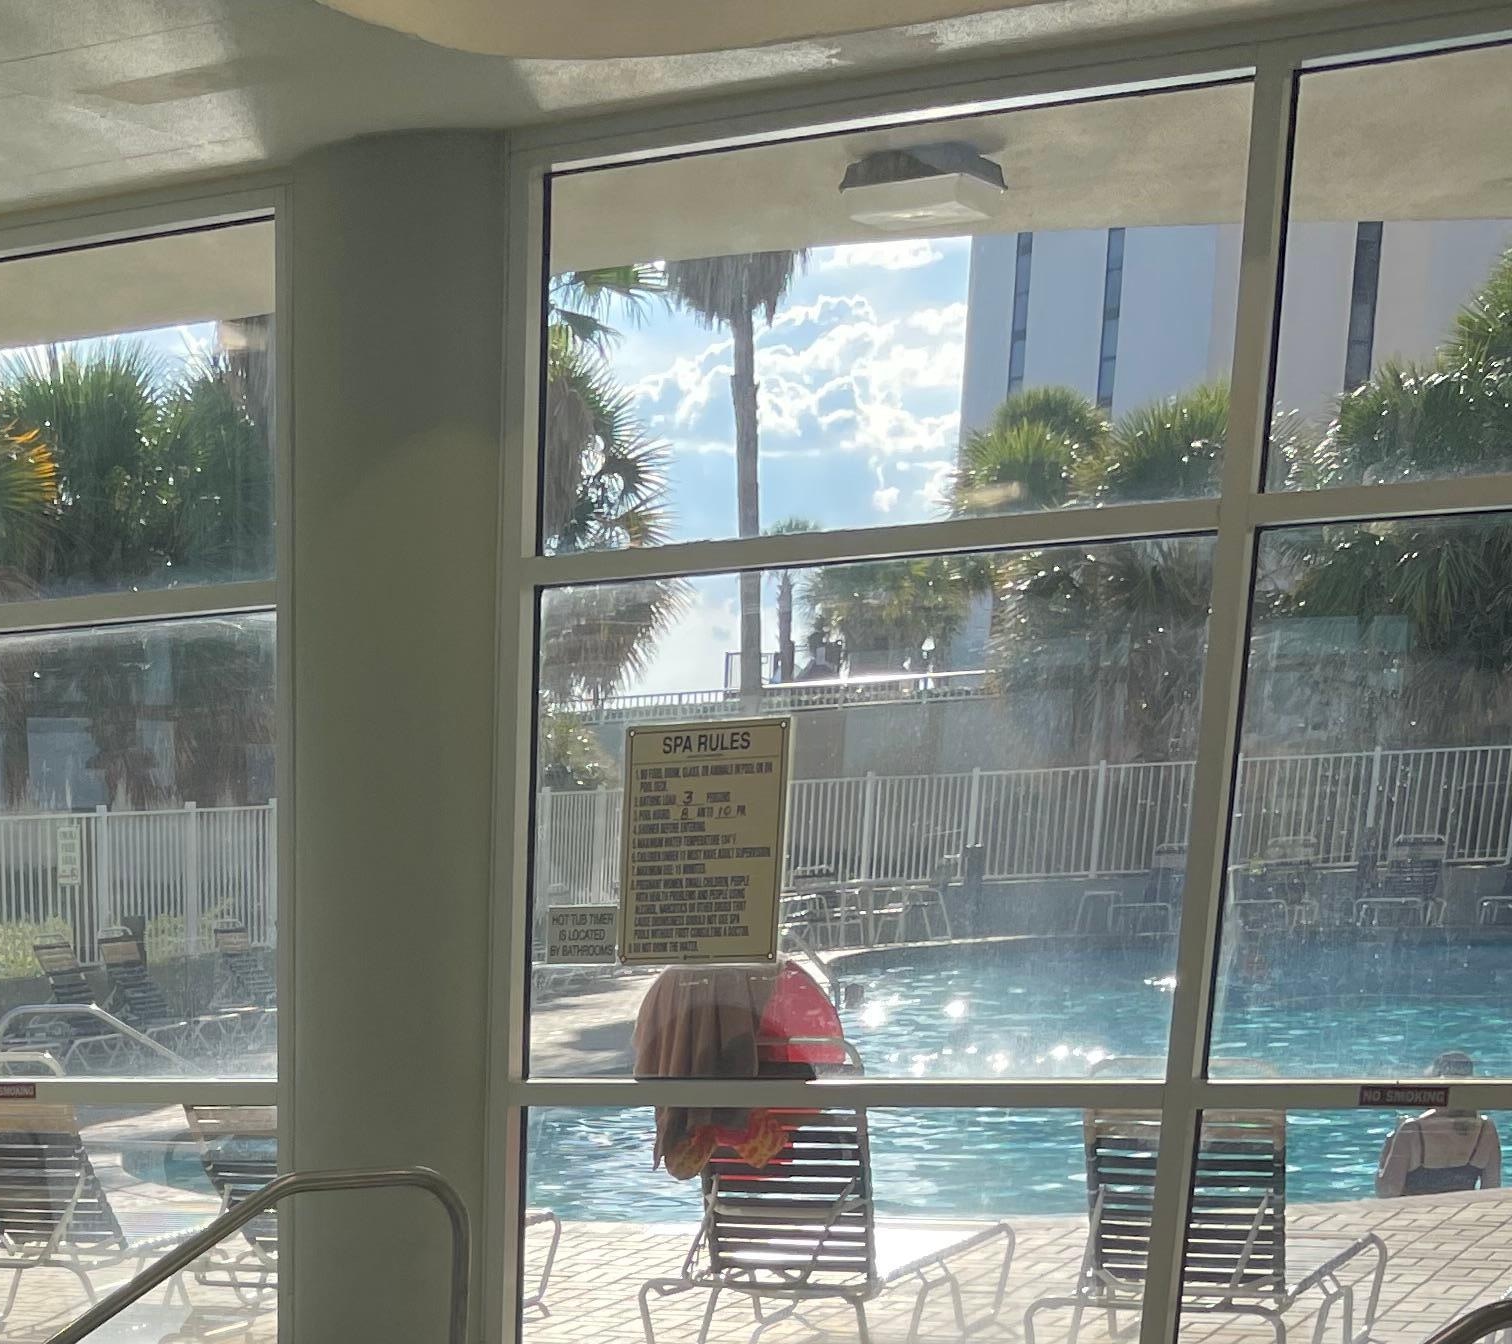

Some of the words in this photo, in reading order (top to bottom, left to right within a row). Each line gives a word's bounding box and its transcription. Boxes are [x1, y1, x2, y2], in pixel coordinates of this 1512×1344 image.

[662, 736, 692, 754] SPA
[697, 732, 751, 752] RULES
[683, 791, 693, 804] 3
[719, 806, 732, 818] 10
[552, 914, 568, 926] HOT
[570, 913, 587, 926] TUB
[589, 913, 614, 926] TIMER
[559, 930, 566, 941] IS
[568, 929, 605, 941] LOCATED
[550, 945, 561, 956] BY
[562, 944, 614, 956] BATHROOMS
[1362, 1088, 1382, 1102] NO
[1386, 1089, 1445, 1102] SMOKING
